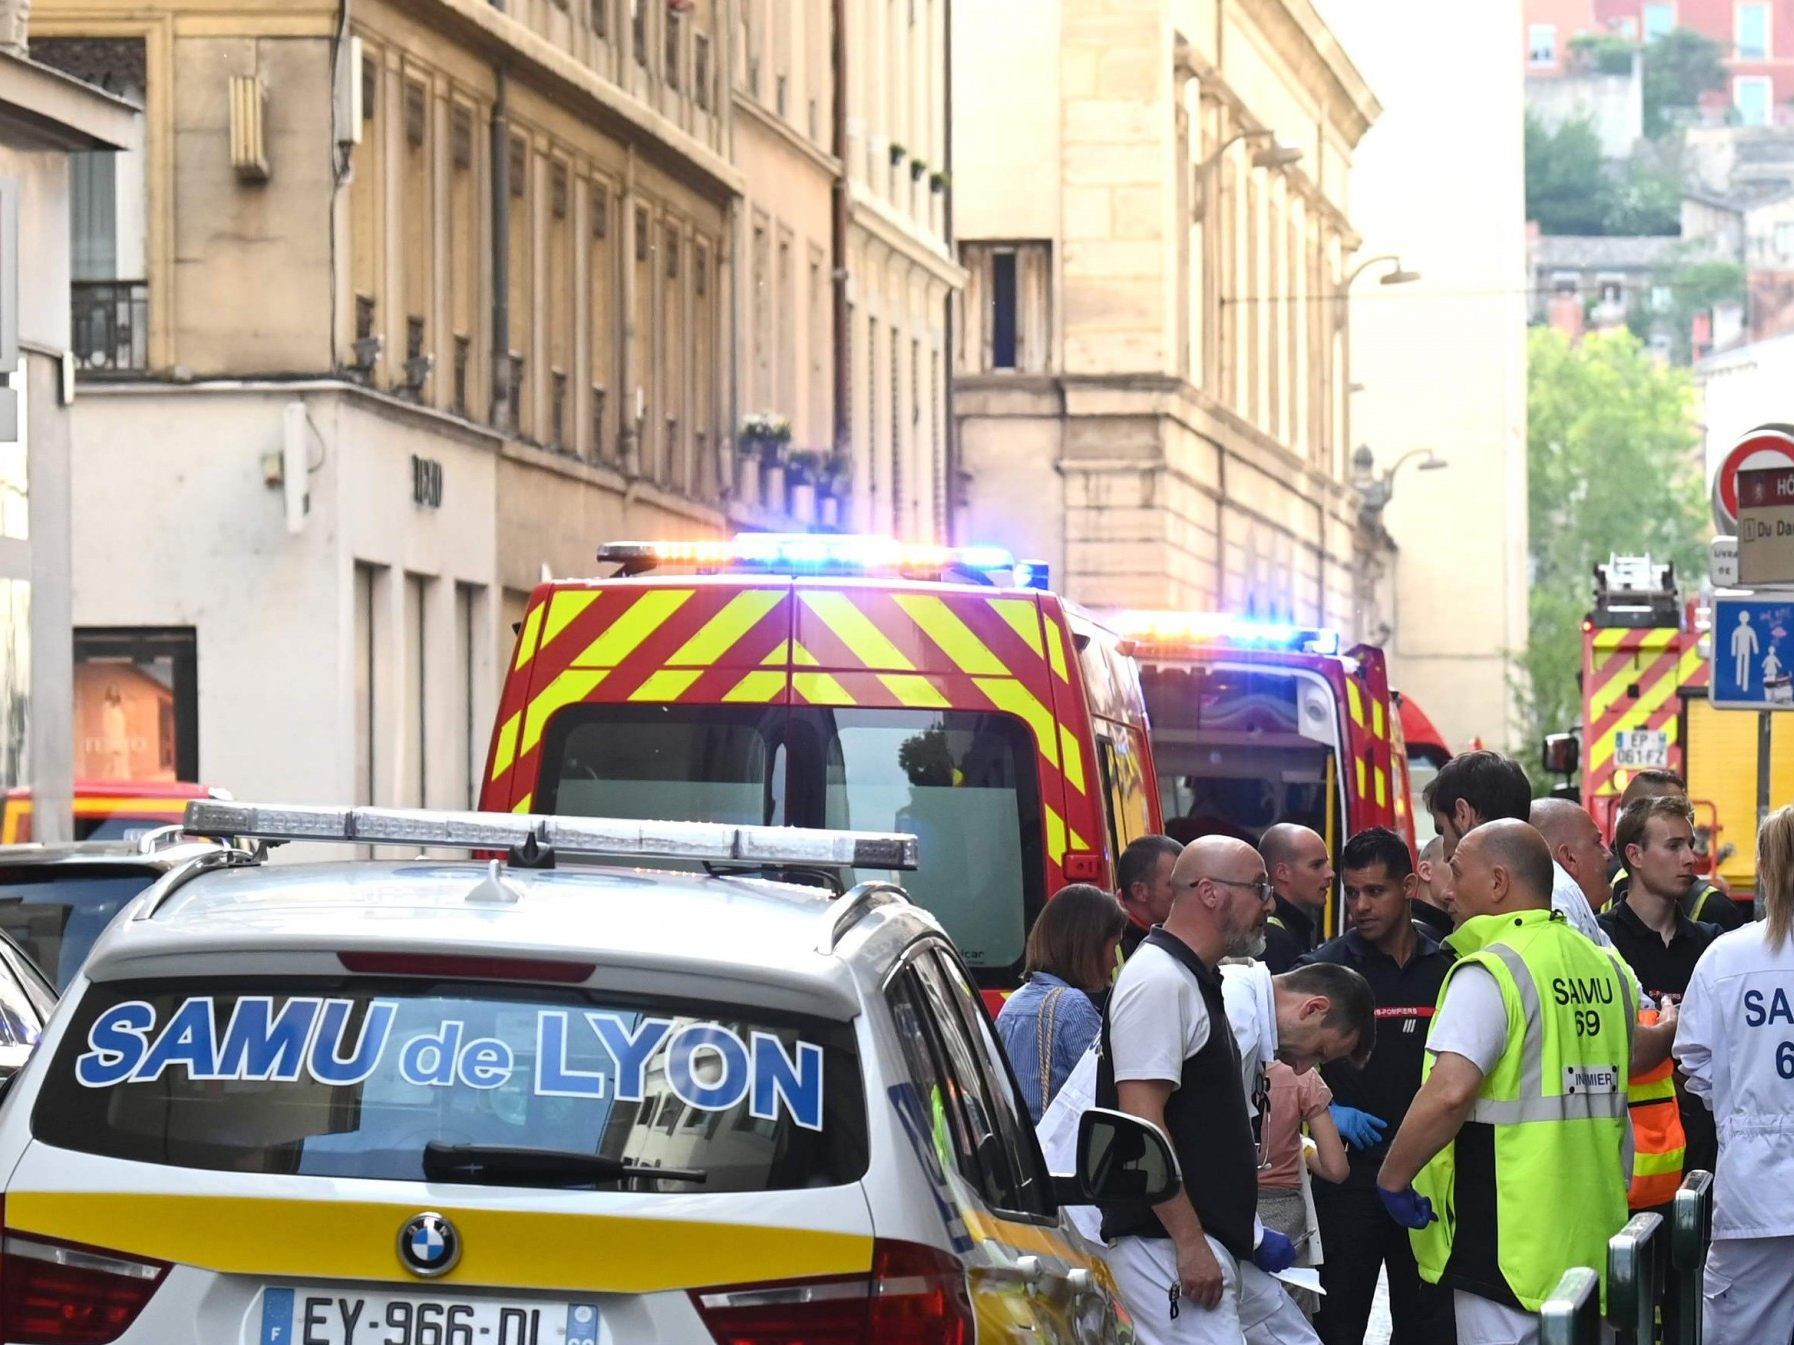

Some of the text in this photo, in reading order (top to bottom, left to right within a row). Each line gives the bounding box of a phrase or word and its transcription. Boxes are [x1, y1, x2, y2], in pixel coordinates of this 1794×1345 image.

[1757, 521, 1772, 537] Du
[1552, 977, 1613, 1006] SAMU
[1574, 1009, 1601, 1038] 69
[75, 996, 824, 1133] SAMU de LYON
[270, 1326, 282, 1342] F
